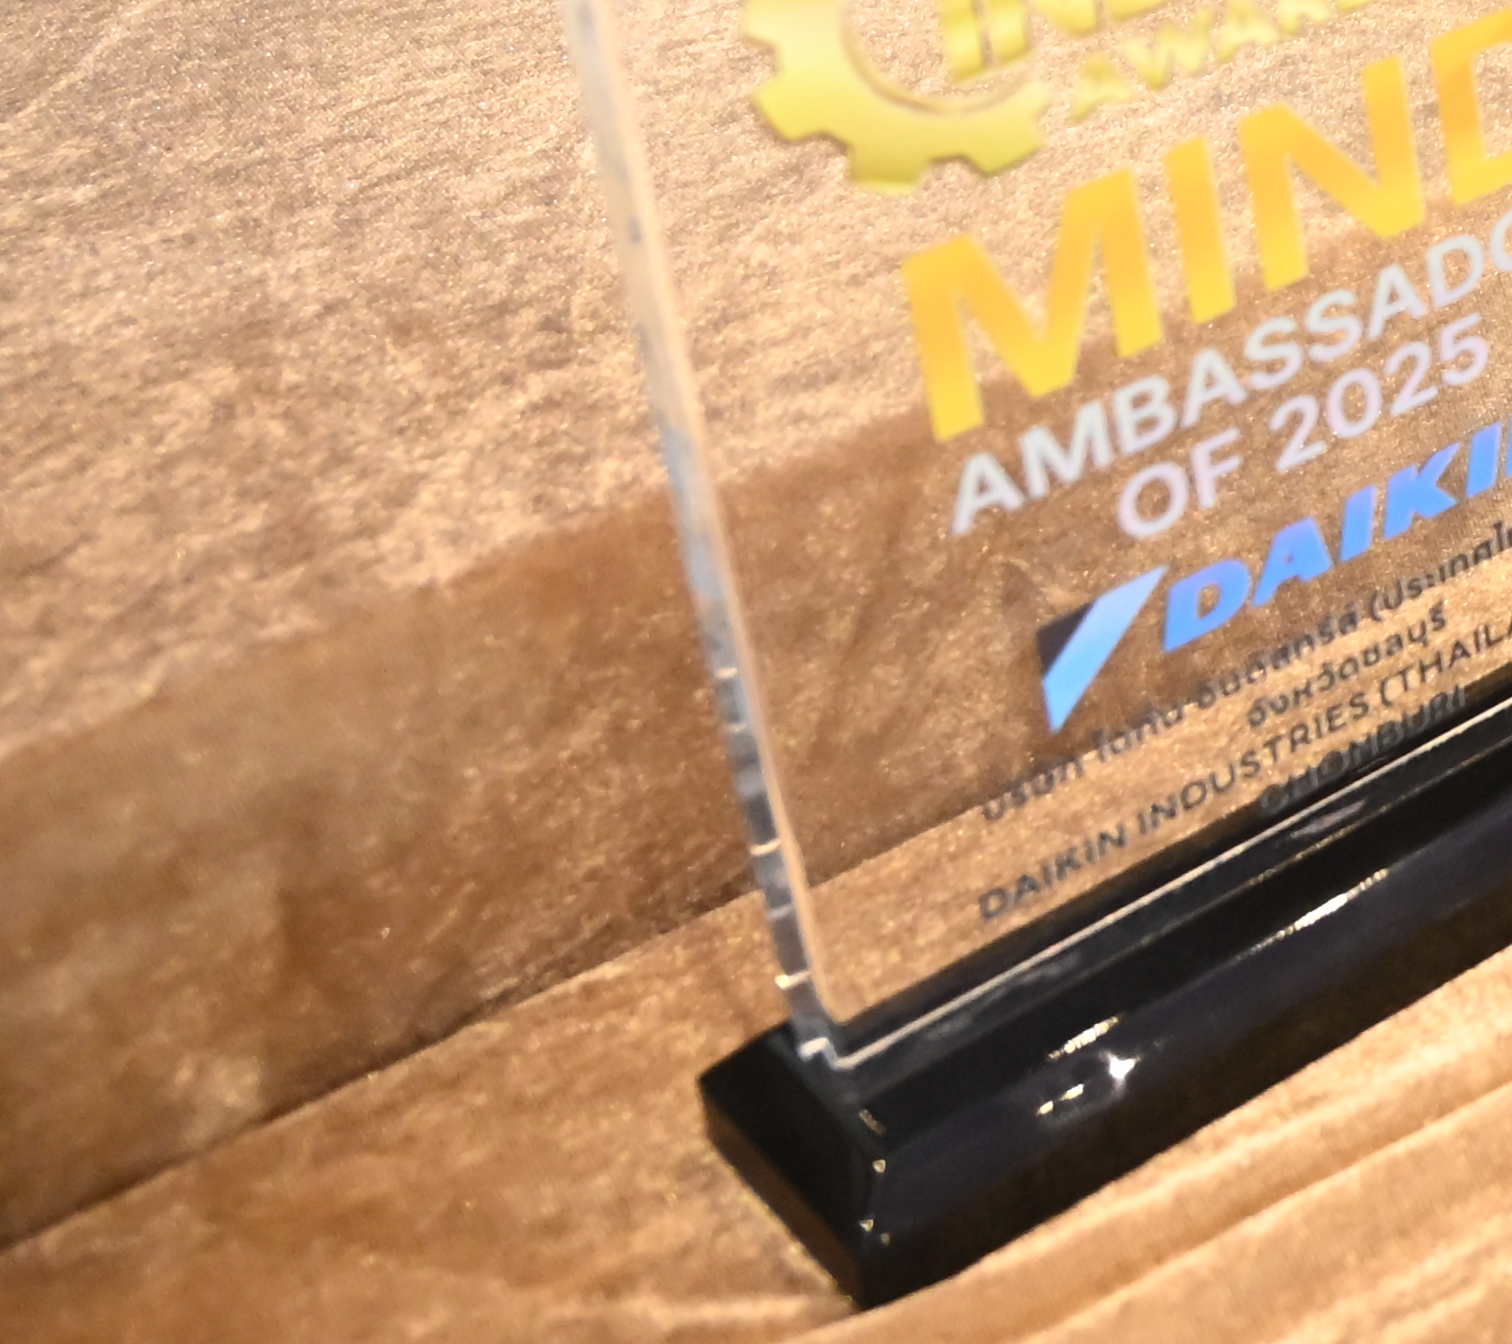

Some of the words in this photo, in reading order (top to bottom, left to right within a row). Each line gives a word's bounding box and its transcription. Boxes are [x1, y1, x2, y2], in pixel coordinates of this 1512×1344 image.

[1117, 427, 1242, 539] OF
[1269, 314, 1490, 473] 2025
[978, 822, 1128, 921] DAIKIN
[1137, 691, 1370, 835] INDUSTRIES
